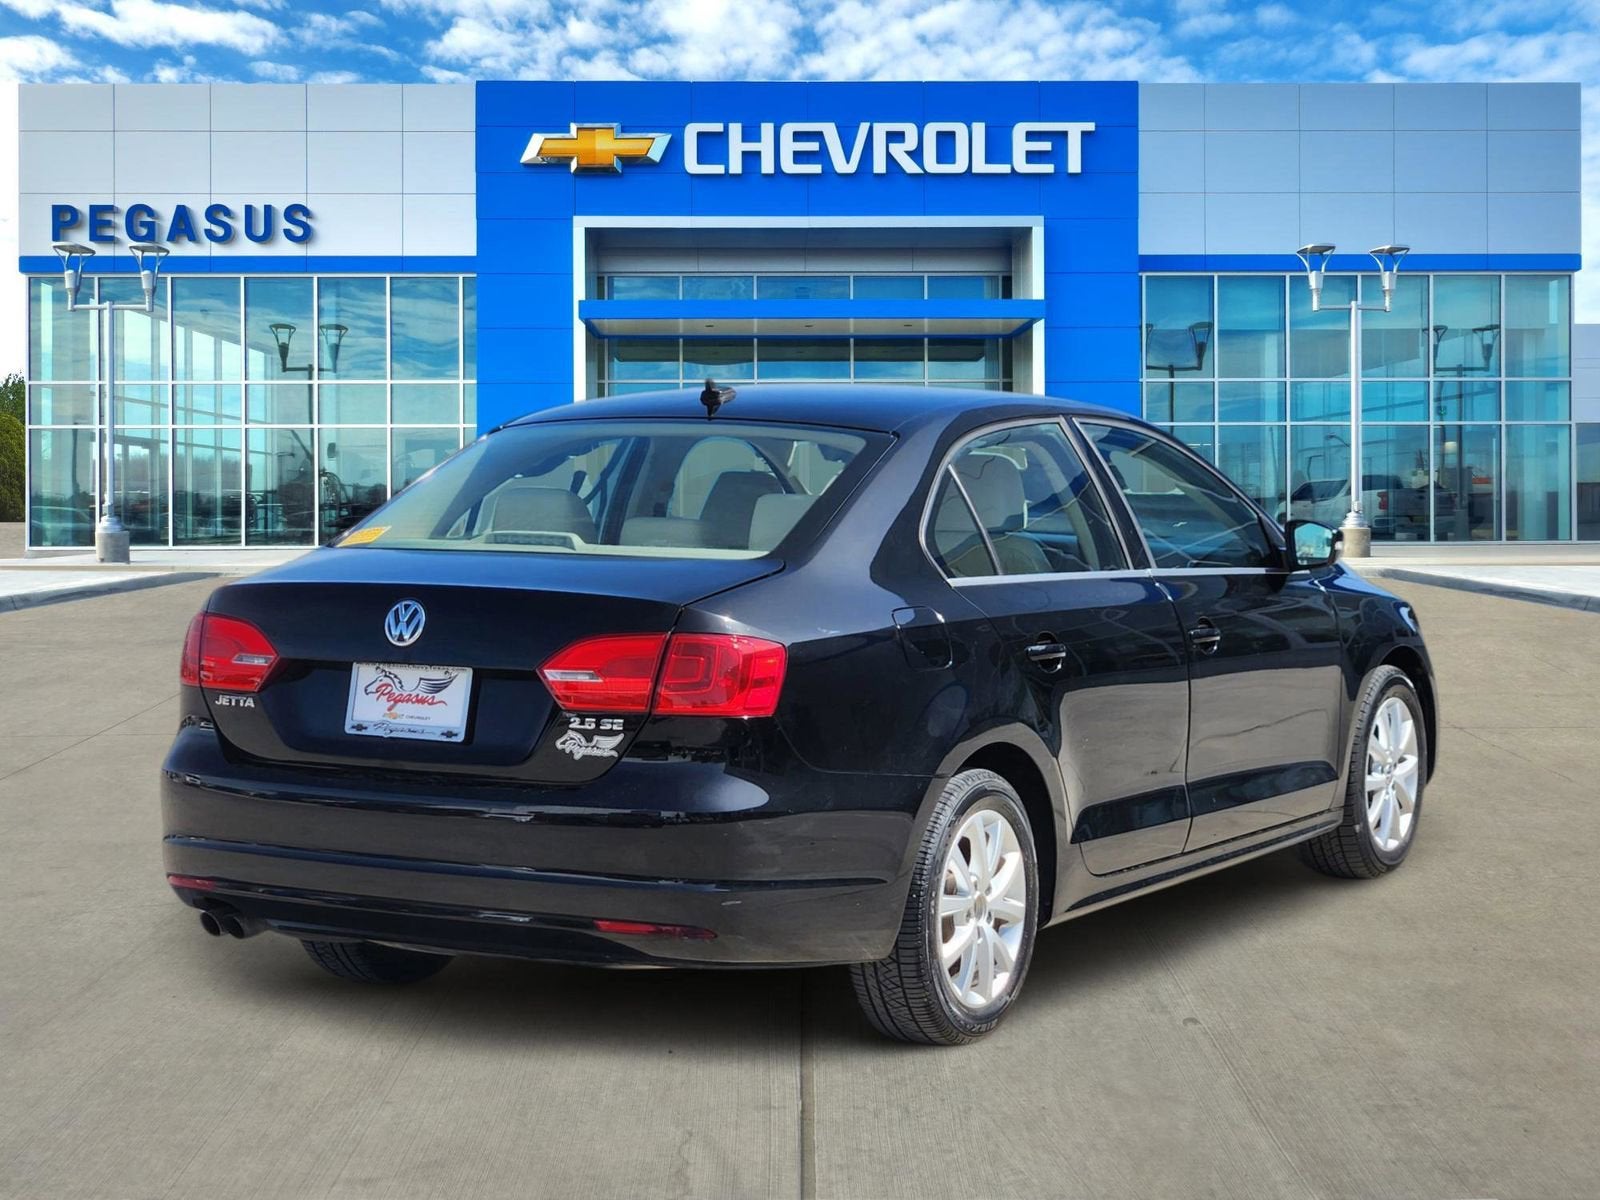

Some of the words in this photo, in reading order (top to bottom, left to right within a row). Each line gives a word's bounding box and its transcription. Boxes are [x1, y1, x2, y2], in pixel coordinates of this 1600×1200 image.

[684, 122, 1095, 174] CHEVROLET
[51, 203, 313, 244] PEGASUS
[215, 694, 256, 708] JETTA
[375, 682, 448, 712] Pegasus
[600, 718, 624, 731] SE
